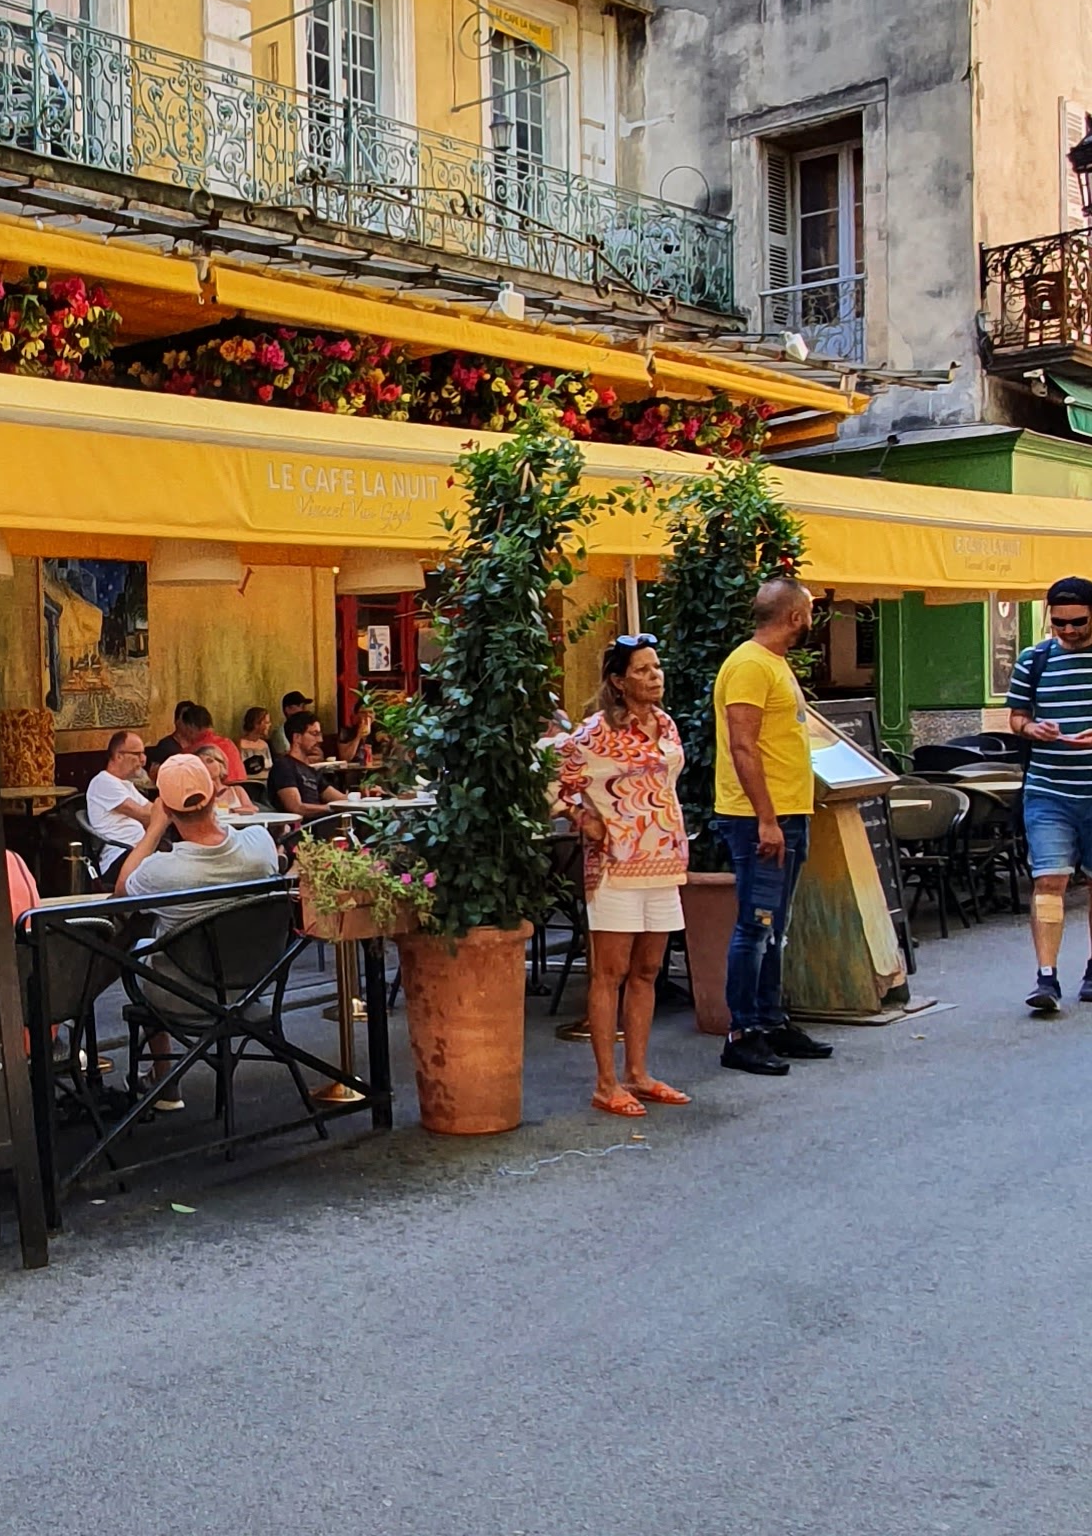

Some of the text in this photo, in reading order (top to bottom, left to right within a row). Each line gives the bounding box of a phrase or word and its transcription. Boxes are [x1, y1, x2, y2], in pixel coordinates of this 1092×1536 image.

[267, 462, 440, 501] LE CAFE LA NUIT
